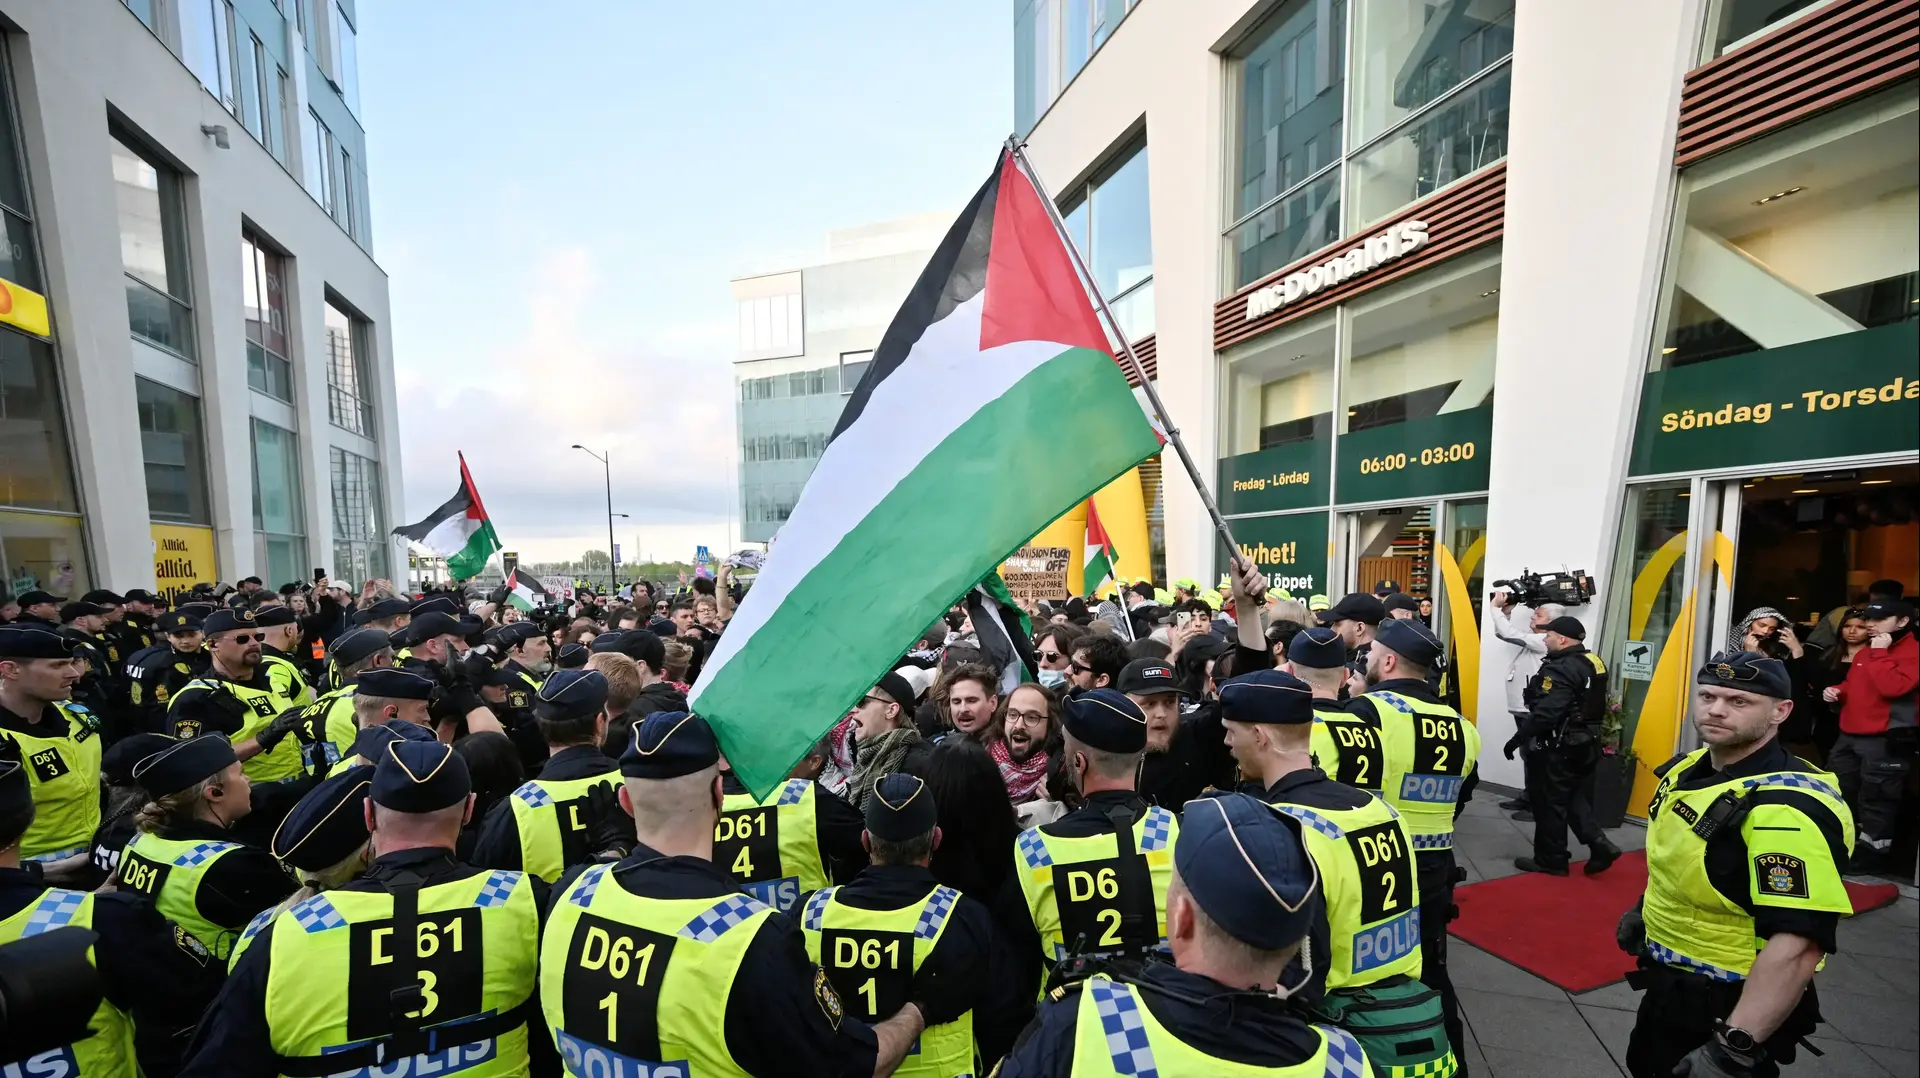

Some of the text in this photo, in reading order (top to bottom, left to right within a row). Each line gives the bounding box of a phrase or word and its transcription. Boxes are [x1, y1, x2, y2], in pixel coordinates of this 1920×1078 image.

[1246, 221, 1429, 320] McDonald's
[1661, 402, 1772, 433] Söndag
[1360, 452, 1406, 475] 06:00
[1420, 441, 1475, 466] 03:00
[1233, 477, 1265, 492] Fredag
[1273, 470, 1310, 487] Lördag
[161, 538, 188, 552] Alltid,
[1012, 548, 1050, 558] ROVISION
[156, 558, 197, 580] alltid,
[1046, 559, 1067, 571] OFF
[1274, 573, 1313, 591] öppet
[250, 697, 268, 706] D61
[261, 705, 271, 714] 3
[1336, 726, 1375, 749] D61
[1421, 718, 1457, 741] D61
[34, 750, 57, 766] D61
[47, 764, 59, 776] 3
[1354, 754, 1369, 784] 2
[1432, 745, 1448, 771] 2
[714, 812, 766, 842] D61
[1674, 803, 1696, 822] POLIS
[732, 846, 755, 878] 4
[1358, 829, 1401, 867] D61
[1759, 856, 1799, 868] POLIS
[124, 858, 158, 894] D61
[1067, 868, 1119, 902] D6
[1381, 871, 1398, 911] 2
[1097, 908, 1124, 947] 2
[1355, 911, 1418, 969] POLIS
[579, 925, 656, 987] D61
[834, 937, 899, 970] D61
[858, 977, 877, 1015] 1
[599, 991, 618, 1043] 1
